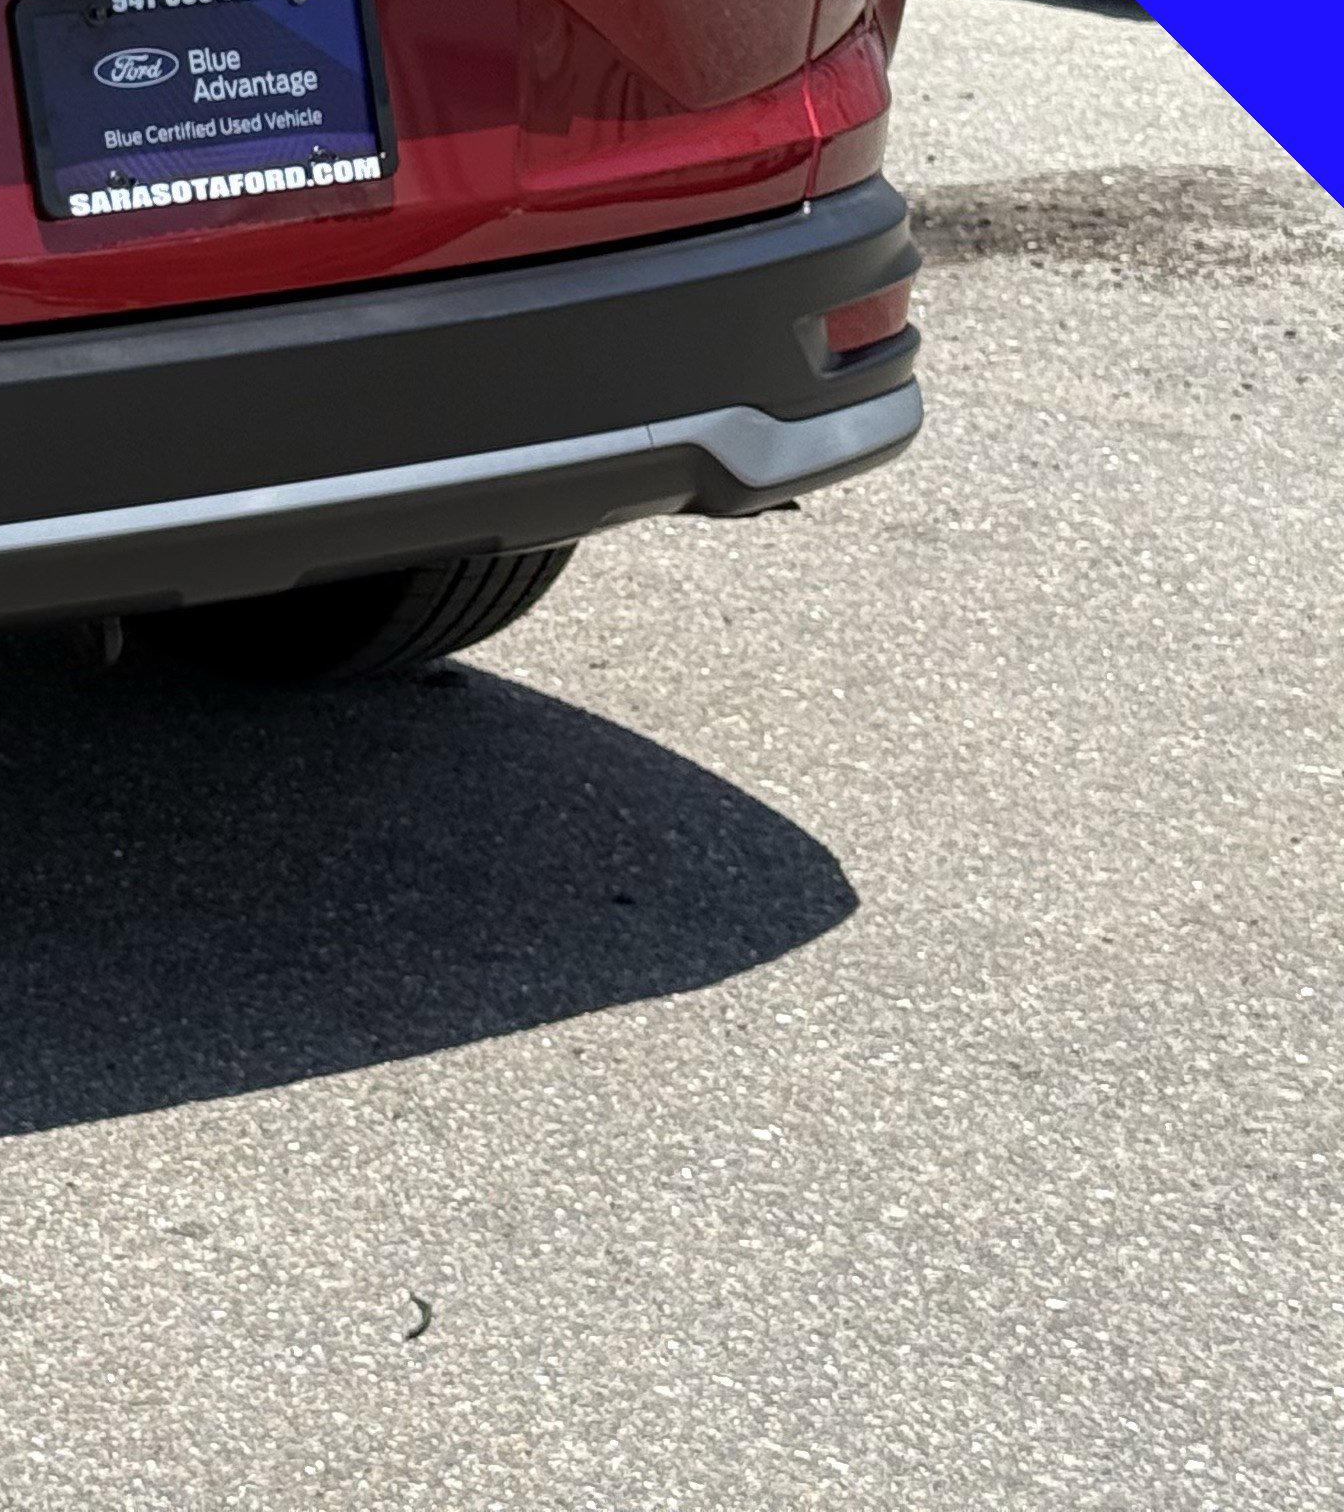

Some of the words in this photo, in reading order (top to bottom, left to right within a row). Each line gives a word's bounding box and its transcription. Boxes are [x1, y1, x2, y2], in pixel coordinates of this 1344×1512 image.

[111, 54, 163, 82] Ford
[188, 47, 242, 75] Blue
[193, 69, 318, 103] Advantage
[104, 129, 143, 149] Blue
[145, 118, 216, 143] Certified
[219, 113, 262, 136] Used
[263, 106, 323, 130] Vehicle
[69, 155, 382, 218] SARASOTAFORD.COM
